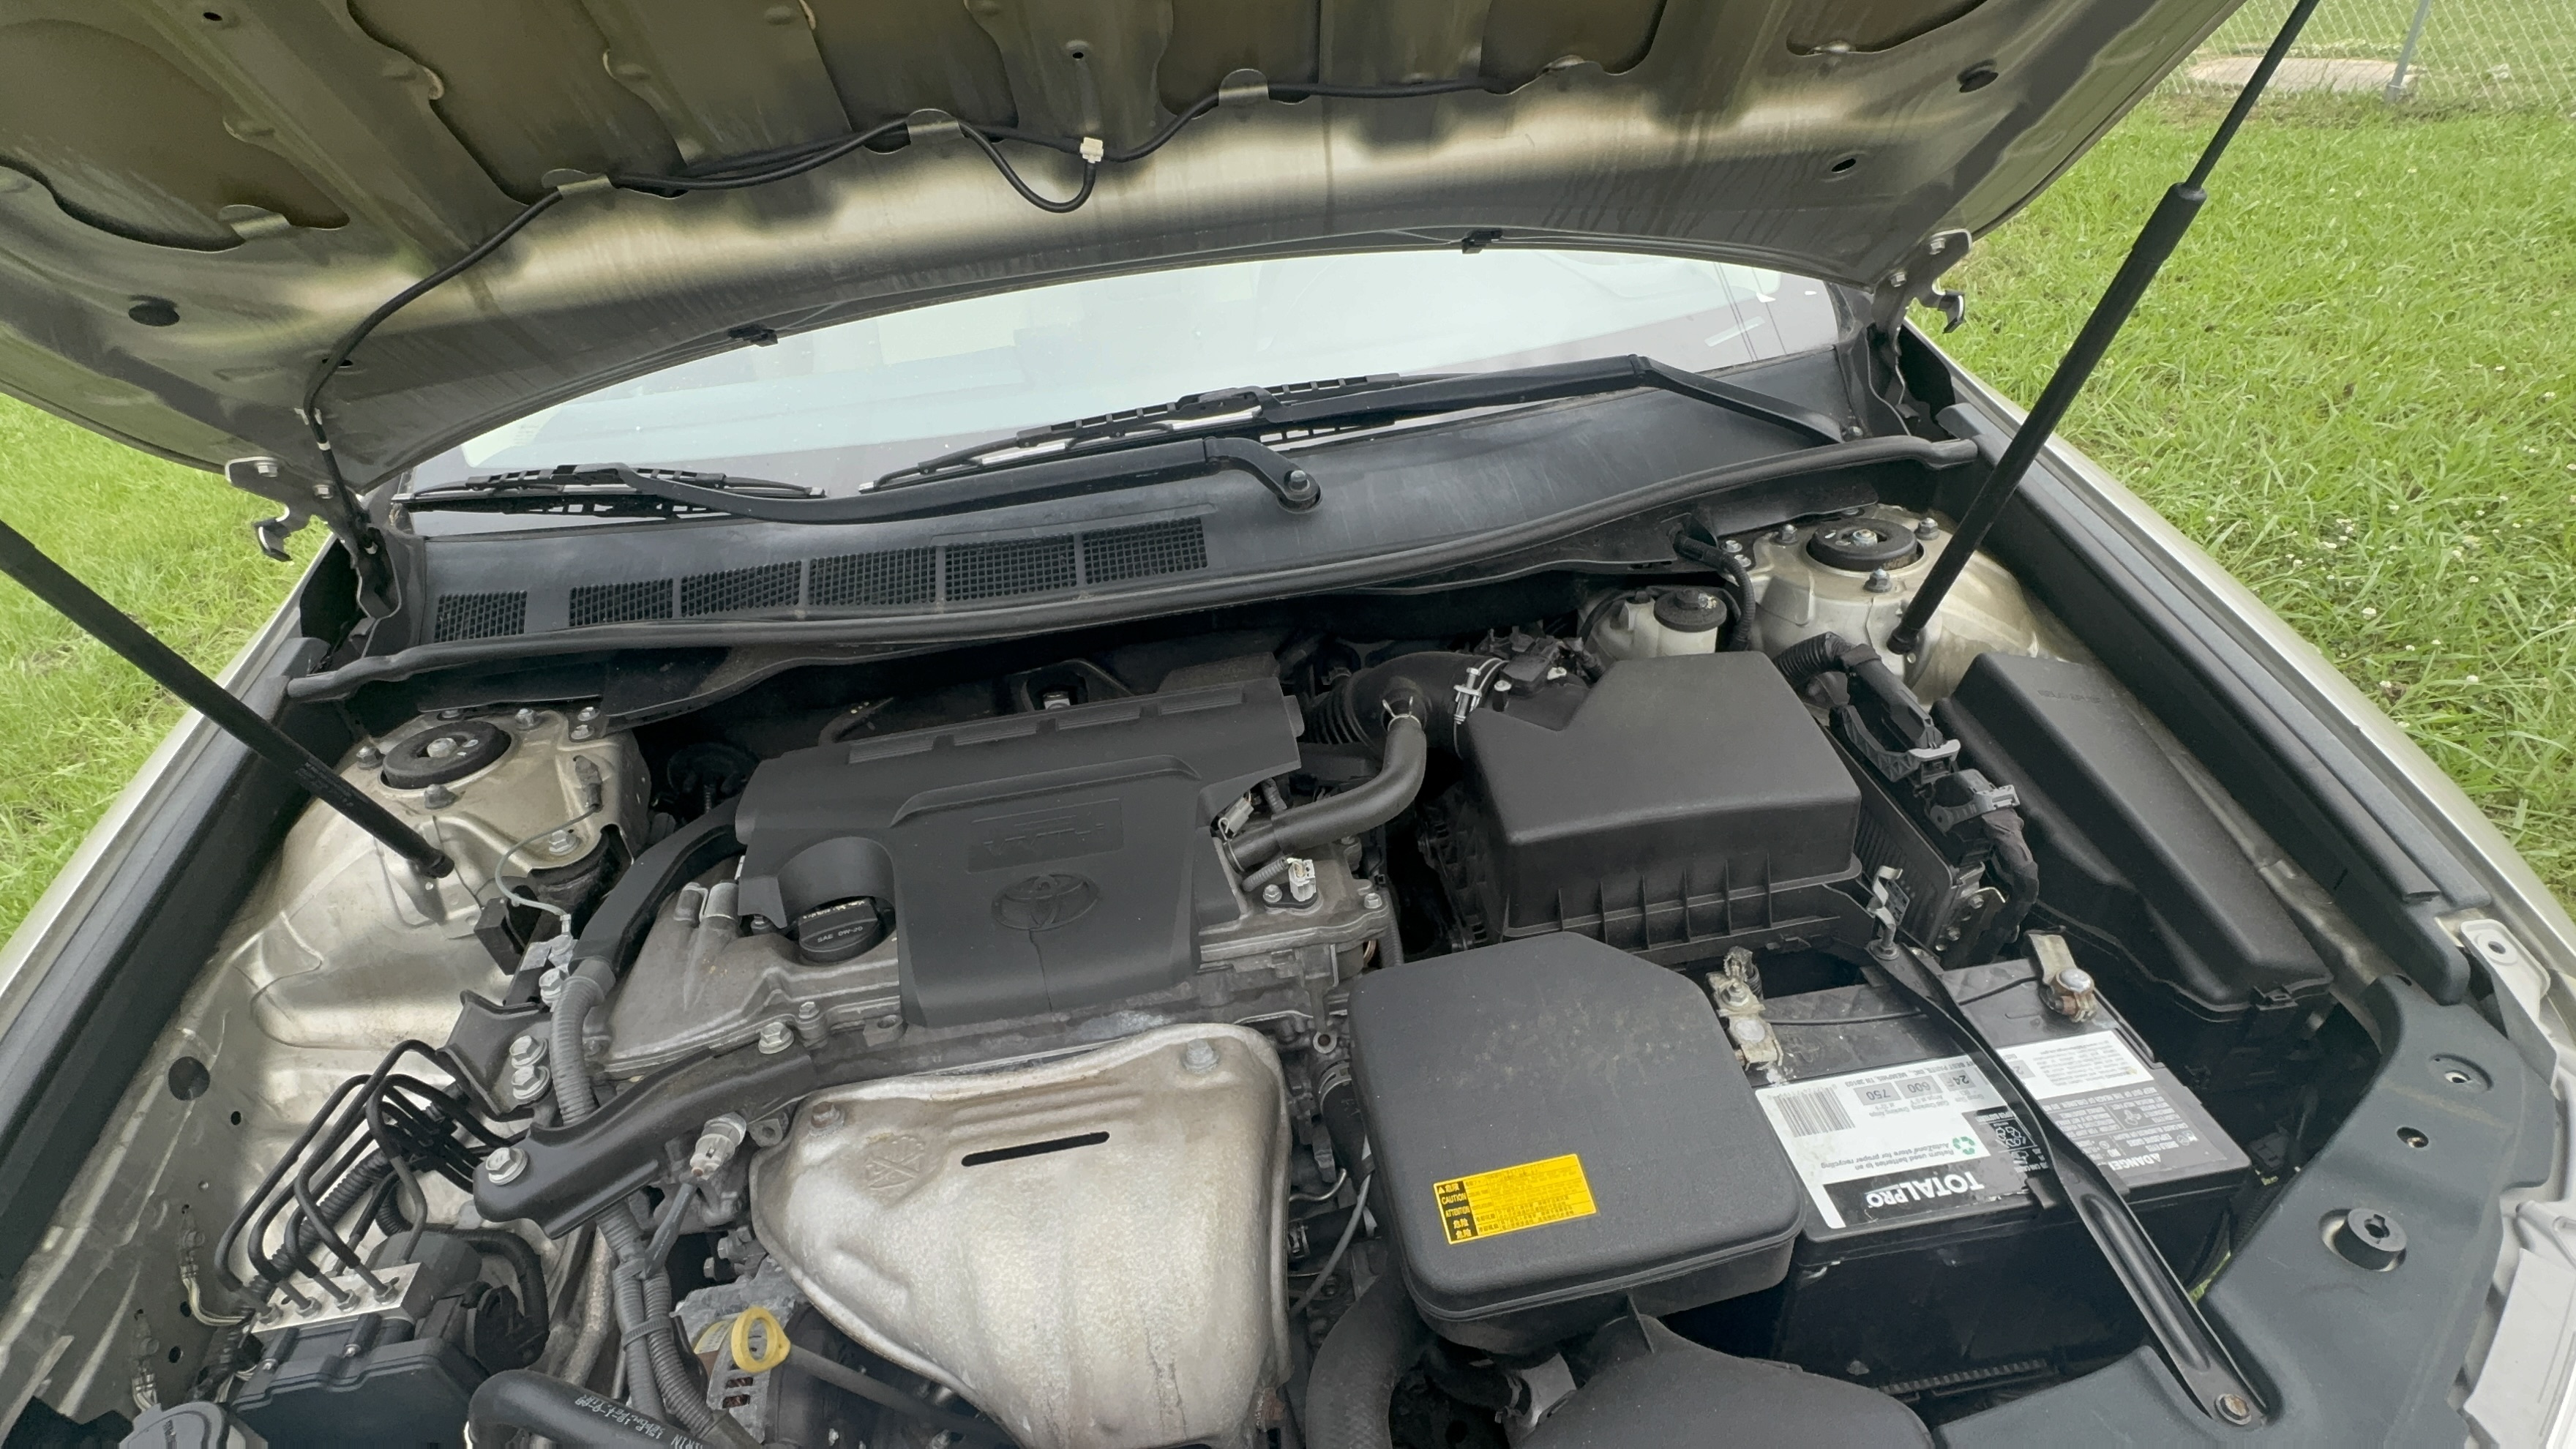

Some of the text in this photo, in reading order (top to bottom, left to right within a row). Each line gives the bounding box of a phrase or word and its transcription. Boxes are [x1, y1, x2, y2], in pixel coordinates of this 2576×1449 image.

[817, 933, 834, 943] SAE
[1946, 1074, 1970, 1087] 24F
[1907, 1081, 1931, 1093] 600
[1866, 1088, 1891, 1101] 750
[1882, 1151, 1892, 1159] for
[1893, 1147, 1914, 1156] store
[1929, 1149, 1955, 1158] Return
[1856, 1153, 1880, 1164] proper
[1874, 1156, 1909, 1167] batteries
[1909, 1153, 1928, 1162] used
[1820, 1158, 1854, 1169] recycling
[1865, 1161, 1874, 1169] to
[1441, 1193, 1467, 1205] CAUTION
